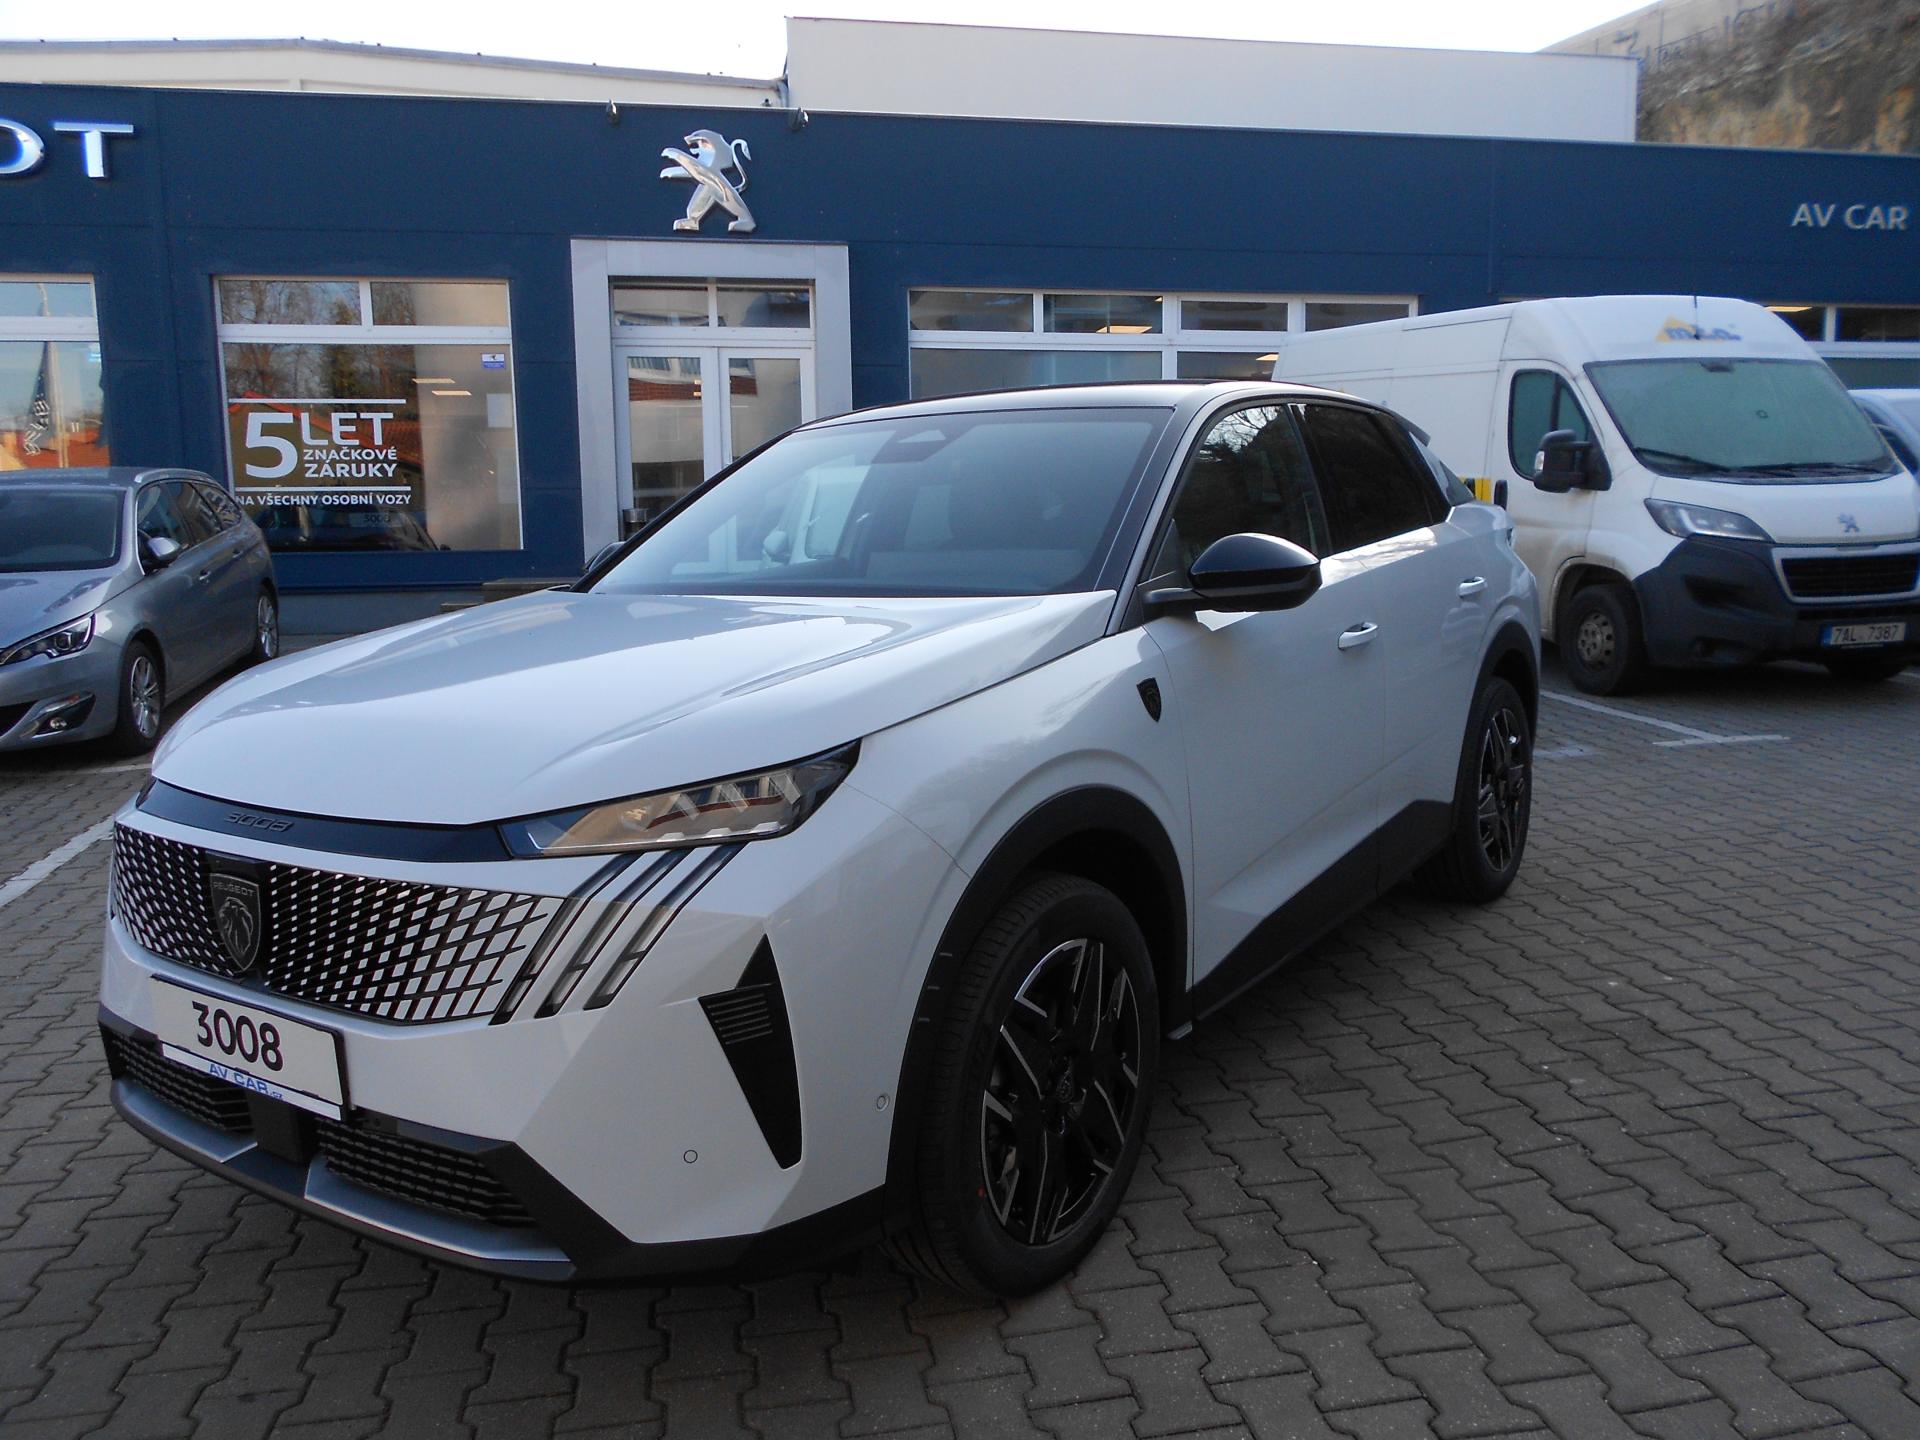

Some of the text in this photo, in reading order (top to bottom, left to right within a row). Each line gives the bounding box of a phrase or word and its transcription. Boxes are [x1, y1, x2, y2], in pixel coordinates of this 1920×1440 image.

[1791, 203, 1908, 230] AV CAR
[245, 412, 394, 479] 5 LET
[303, 446, 398, 461] ZNAČKOVÉ
[304, 457, 397, 478] ZÁRUKY
[257, 493, 319, 506] VŠECHNY
[321, 492, 374, 505] OSOBNÍ
[376, 494, 411, 505] VOZY
[1834, 627, 1857, 642] 7AL
[225, 811, 295, 833] 3008
[212, 881, 256, 897] PEUGEOT
[192, 1000, 283, 1072] 3008
[209, 1063, 228, 1079] AV
